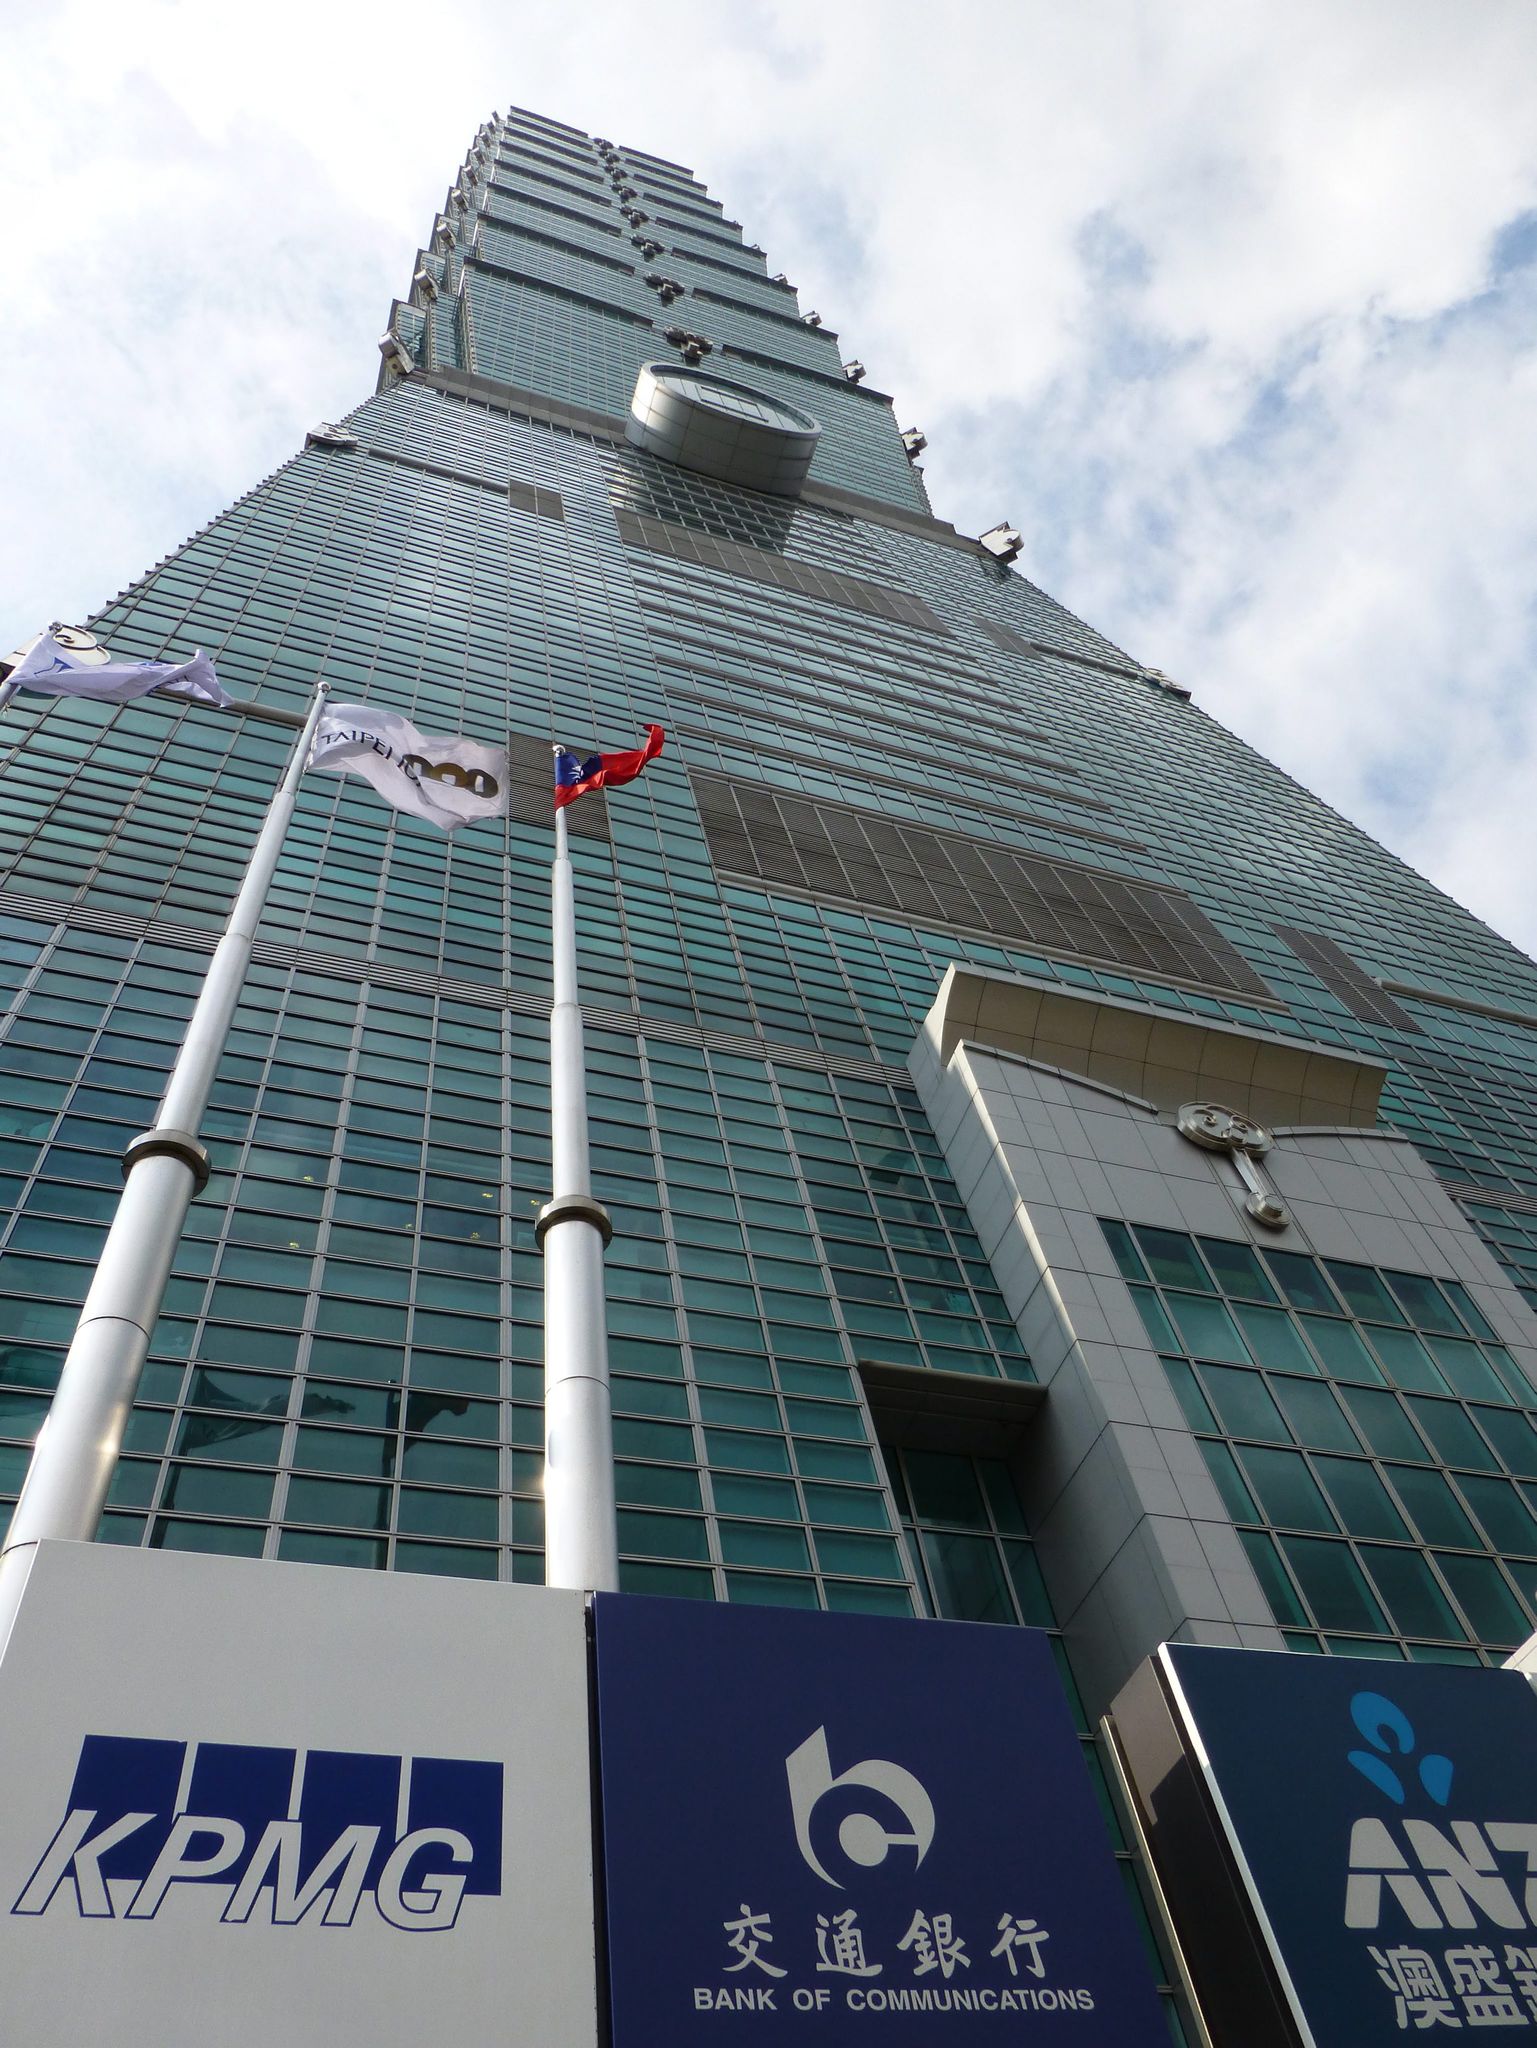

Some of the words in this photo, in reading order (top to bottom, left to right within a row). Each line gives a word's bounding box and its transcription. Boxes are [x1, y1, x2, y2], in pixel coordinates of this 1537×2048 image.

[321, 730, 393, 760] TAIPEI
[10, 1808, 475, 1932] KPMG
[723, 1903, 1049, 1979] 交通銀行
[694, 1987, 776, 2011] BANK
[793, 1989, 830, 2011] OF
[847, 1989, 1094, 2011] COMMUNICATIONS
